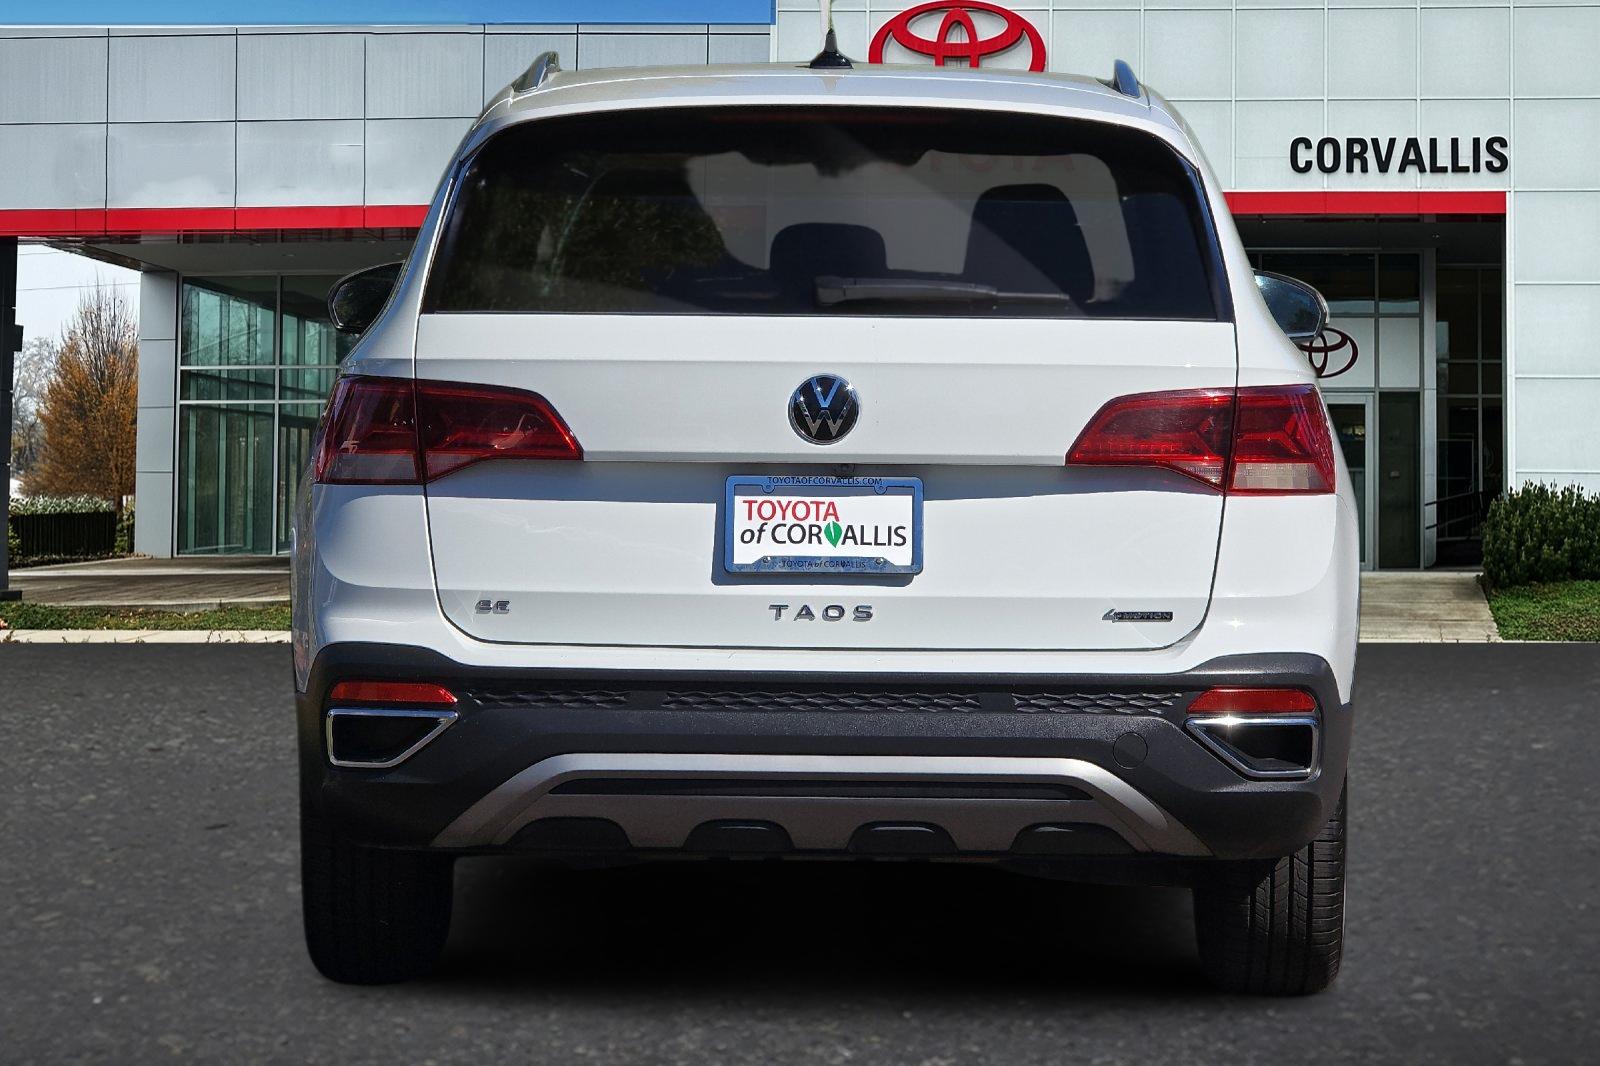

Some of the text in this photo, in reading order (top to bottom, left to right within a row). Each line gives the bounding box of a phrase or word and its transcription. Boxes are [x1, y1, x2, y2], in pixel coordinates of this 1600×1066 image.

[1289, 136, 1509, 174] CORVALLIS
[767, 476, 883, 486] TOYOTAOFCORVALLIS.COM
[742, 499, 840, 522] TOYOTA
[740, 522, 769, 545] of
[781, 560, 813, 569] TOYOTA
[768, 604, 874, 622] TAOS
